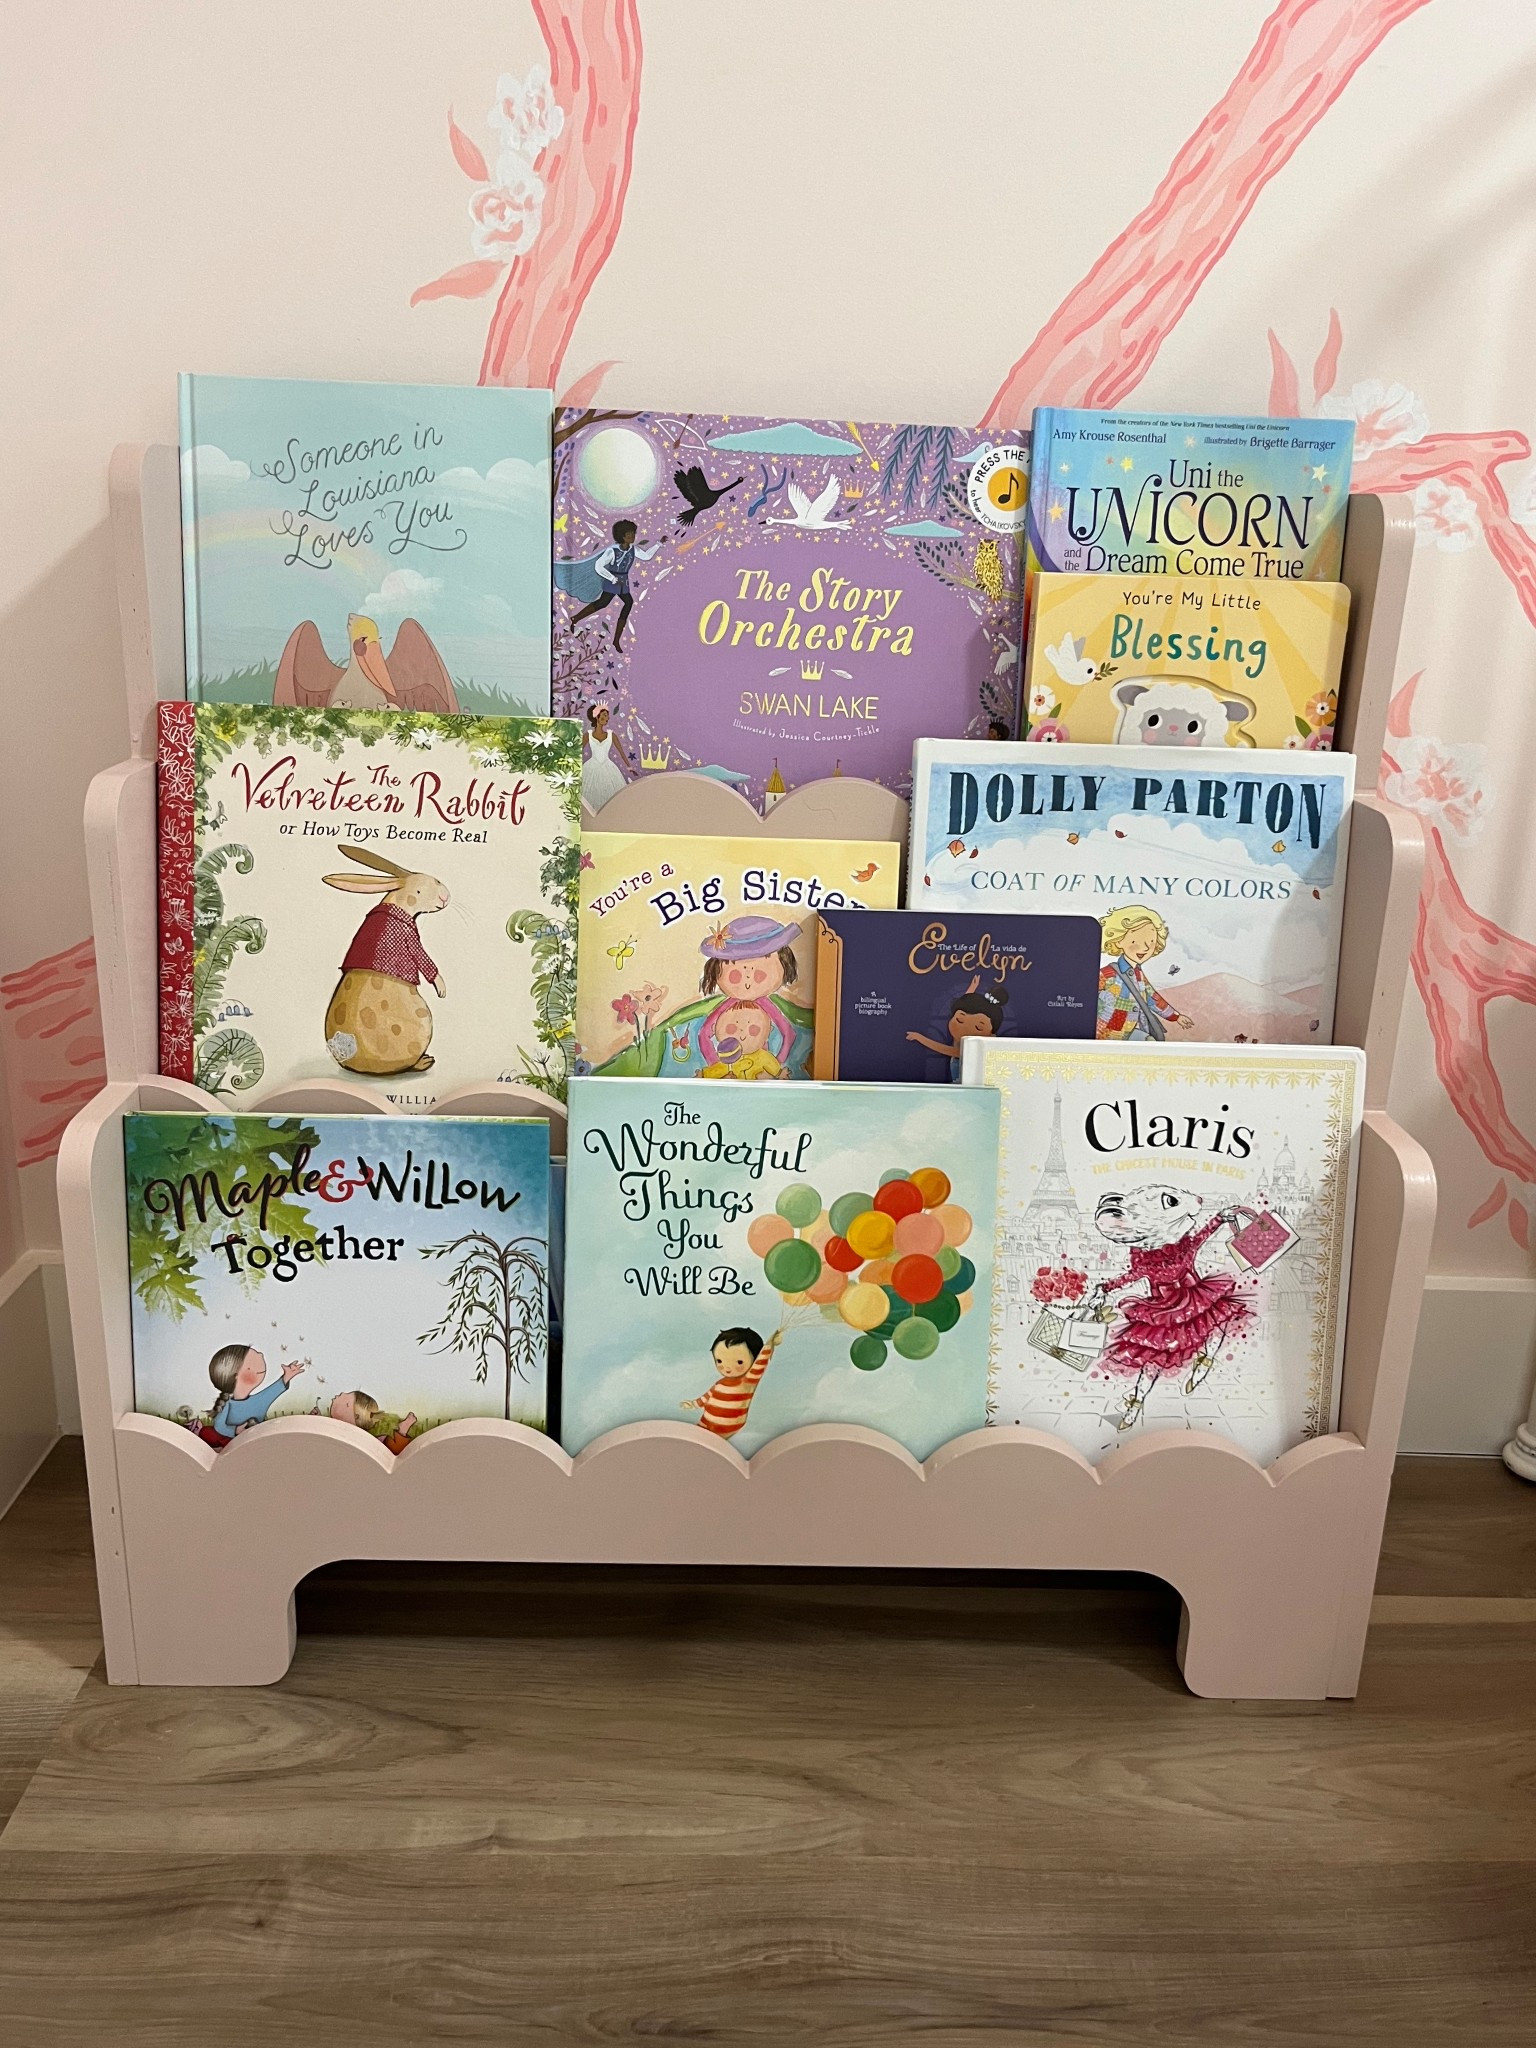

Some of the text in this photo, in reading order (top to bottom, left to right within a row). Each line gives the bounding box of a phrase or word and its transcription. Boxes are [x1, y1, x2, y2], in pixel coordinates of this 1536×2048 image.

[249, 421, 444, 485] Someone in
[1053, 428, 1167, 444] Amy Krouse Rosenthal
[1204, 436, 1337, 452] illustrated by Brigette Barrager
[974, 449, 1026, 483] PRESS THE
[1169, 458, 1244, 488] Uni the
[297, 464, 437, 522] Louisiana
[1066, 474, 1314, 549] UNICORN
[268, 499, 468, 570] Loves You
[1063, 547, 1082, 558] and
[1064, 546, 1304, 579] the Dream Come True
[735, 566, 903, 622] The Story
[1122, 590, 1261, 611] You're My Little
[697, 599, 915, 656] Orchestra
[1110, 613, 1267, 679] Blessing
[738, 691, 880, 720] SWAN LAKE
[732, 718, 880, 741] Illustrated by Jessica Courtney-Tickle
[230, 755, 531, 826] Velveteen Rabbit
[367, 764, 402, 788] The
[279, 820, 488, 844] or How Toys Become Real
[946, 771, 1326, 850] DOLLY PARTON
[588, 863, 675, 917] You're a
[650, 876, 726, 927] Big
[970, 870, 1292, 900] COAT OF MANY COLORS
[908, 921, 1033, 983] Evelyn
[937, 943, 977, 951] The Life of
[990, 944, 1027, 952] La vida de
[663, 1101, 702, 1127] The
[1084, 1098, 1256, 1159] Claris
[583, 1118, 813, 1180] Wonderful
[1091, 1162, 1111, 1175] THE
[1161, 1157, 1198, 1171] MOUSE
[1201, 1161, 1213, 1173] IN
[1216, 1163, 1247, 1180] PARIS
[144, 1142, 321, 1232] Maple
[317, 1159, 374, 1203] &
[619, 1167, 755, 1223] Things
[211, 1224, 405, 1283] Together
[656, 1217, 724, 1260] You
[624, 1265, 757, 1297] Will Be
